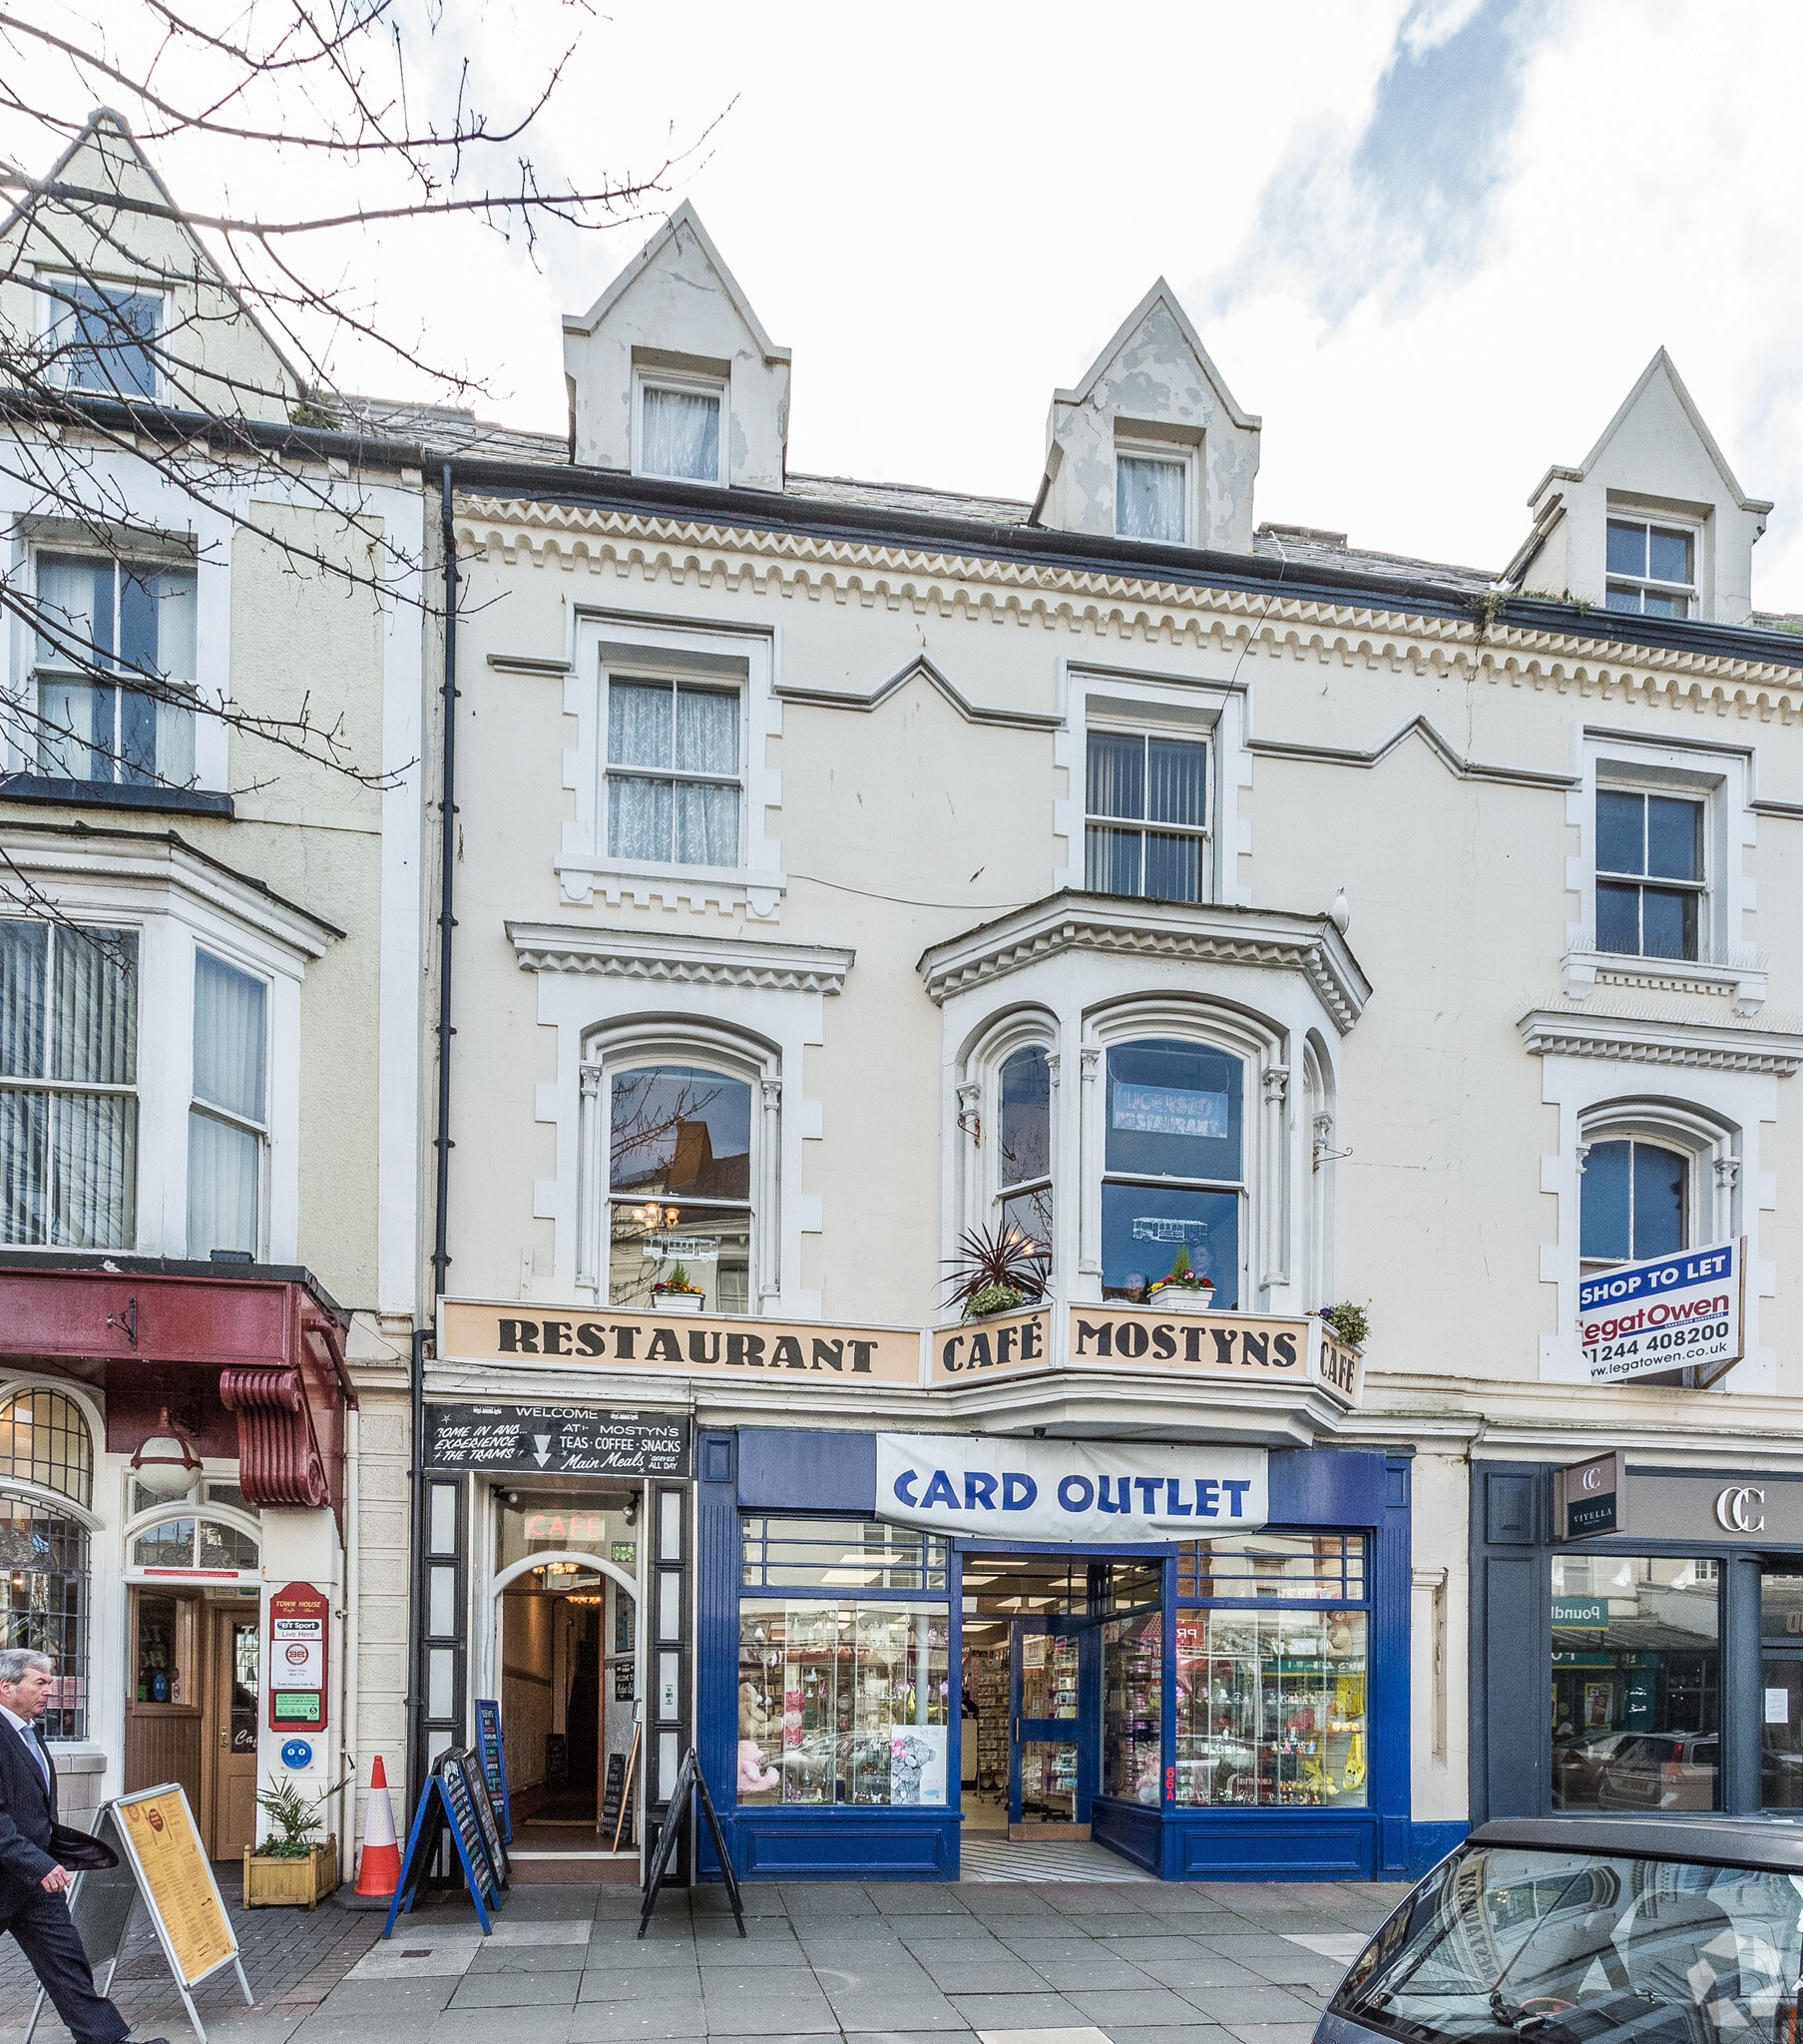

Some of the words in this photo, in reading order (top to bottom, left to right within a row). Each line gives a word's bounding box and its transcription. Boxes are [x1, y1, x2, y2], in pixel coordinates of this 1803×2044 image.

[1124, 1091, 1213, 1116] LICENSED
[1115, 1111, 1218, 1136] RESTAURANT
[1580, 1276, 1642, 1304] SHOP
[1648, 1267, 1679, 1288] TO
[1687, 1255, 1726, 1279] LET
[1581, 1294, 1729, 1342] egatOwen
[498, 1318, 878, 1373] RESTAURANT
[942, 1314, 1043, 1372] CAFÉ
[1076, 1319, 1297, 1367] MOSTYNS
[1647, 1321, 1729, 1351] 408200
[1319, 1340, 1355, 1395] CAFÉ
[516, 1407, 599, 1419] WELCOME
[434, 1435, 520, 1450] EXPERIENCE
[473, 1425, 492, 1436] IN
[600, 1424, 679, 1437] MOSTYN'S
[442, 1449, 467, 1461] THE
[469, 1448, 516, 1462] TRAMS
[559, 1435, 589, 1448] TEAS
[595, 1437, 635, 1451] COFFEE
[641, 1439, 681, 1453] SNACKS
[560, 1453, 600, 1470] Main
[600, 1451, 646, 1468] Meals
[664, 1461, 678, 1470] DAY
[893, 1468, 1038, 1511] CARD
[1058, 1474, 1251, 1517] OUTLET
[529, 1514, 601, 1538] CAFE
[1574, 1507, 1612, 1523] VIYELLA
[294, 1621, 315, 1630] Sport
